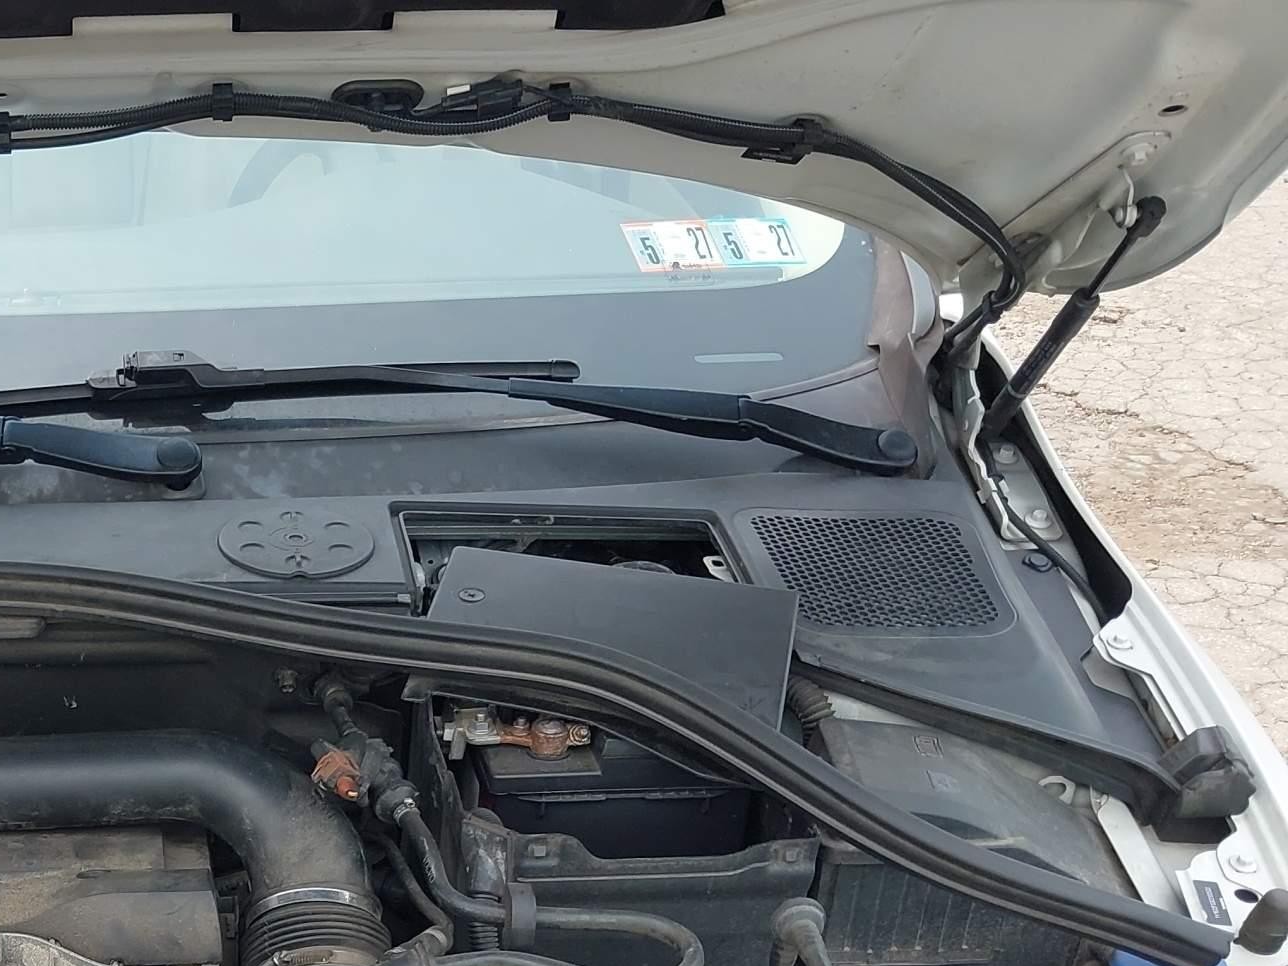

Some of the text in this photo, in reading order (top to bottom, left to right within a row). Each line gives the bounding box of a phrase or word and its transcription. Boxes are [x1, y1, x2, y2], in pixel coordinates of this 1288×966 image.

[640, 226, 713, 265] 5 27
[722, 224, 795, 260] 5 27
